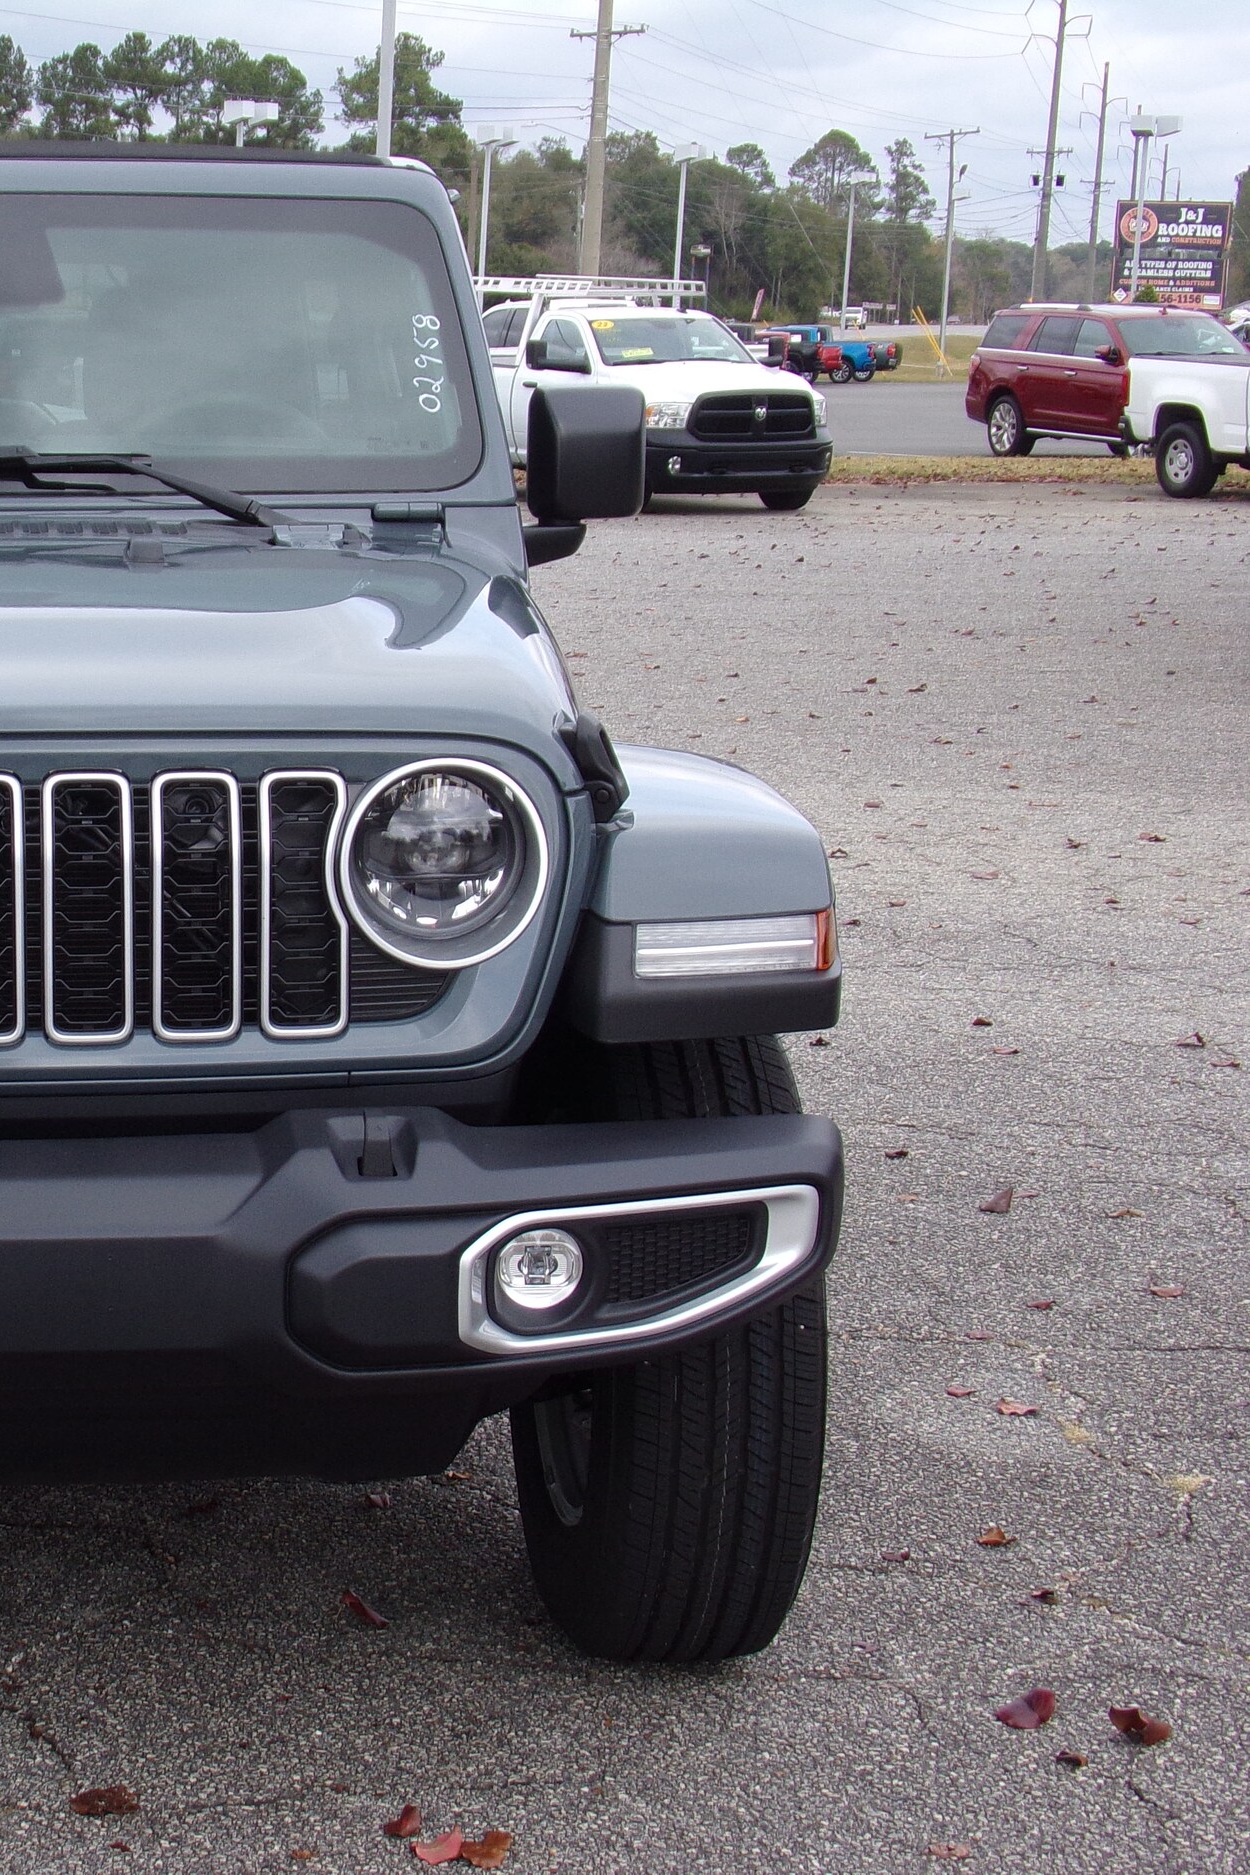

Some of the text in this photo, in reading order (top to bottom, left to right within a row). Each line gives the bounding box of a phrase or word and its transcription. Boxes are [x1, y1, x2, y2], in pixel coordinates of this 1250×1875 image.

[1178, 207, 1205, 223] J&J
[1157, 223, 1223, 237] ROOFING
[1178, 261, 1213, 269] ROOFING
[1175, 269, 1212, 277] GUTTERS
[1158, 294, 1201, 304] 56-1156
[412, 314, 444, 413] 02958
